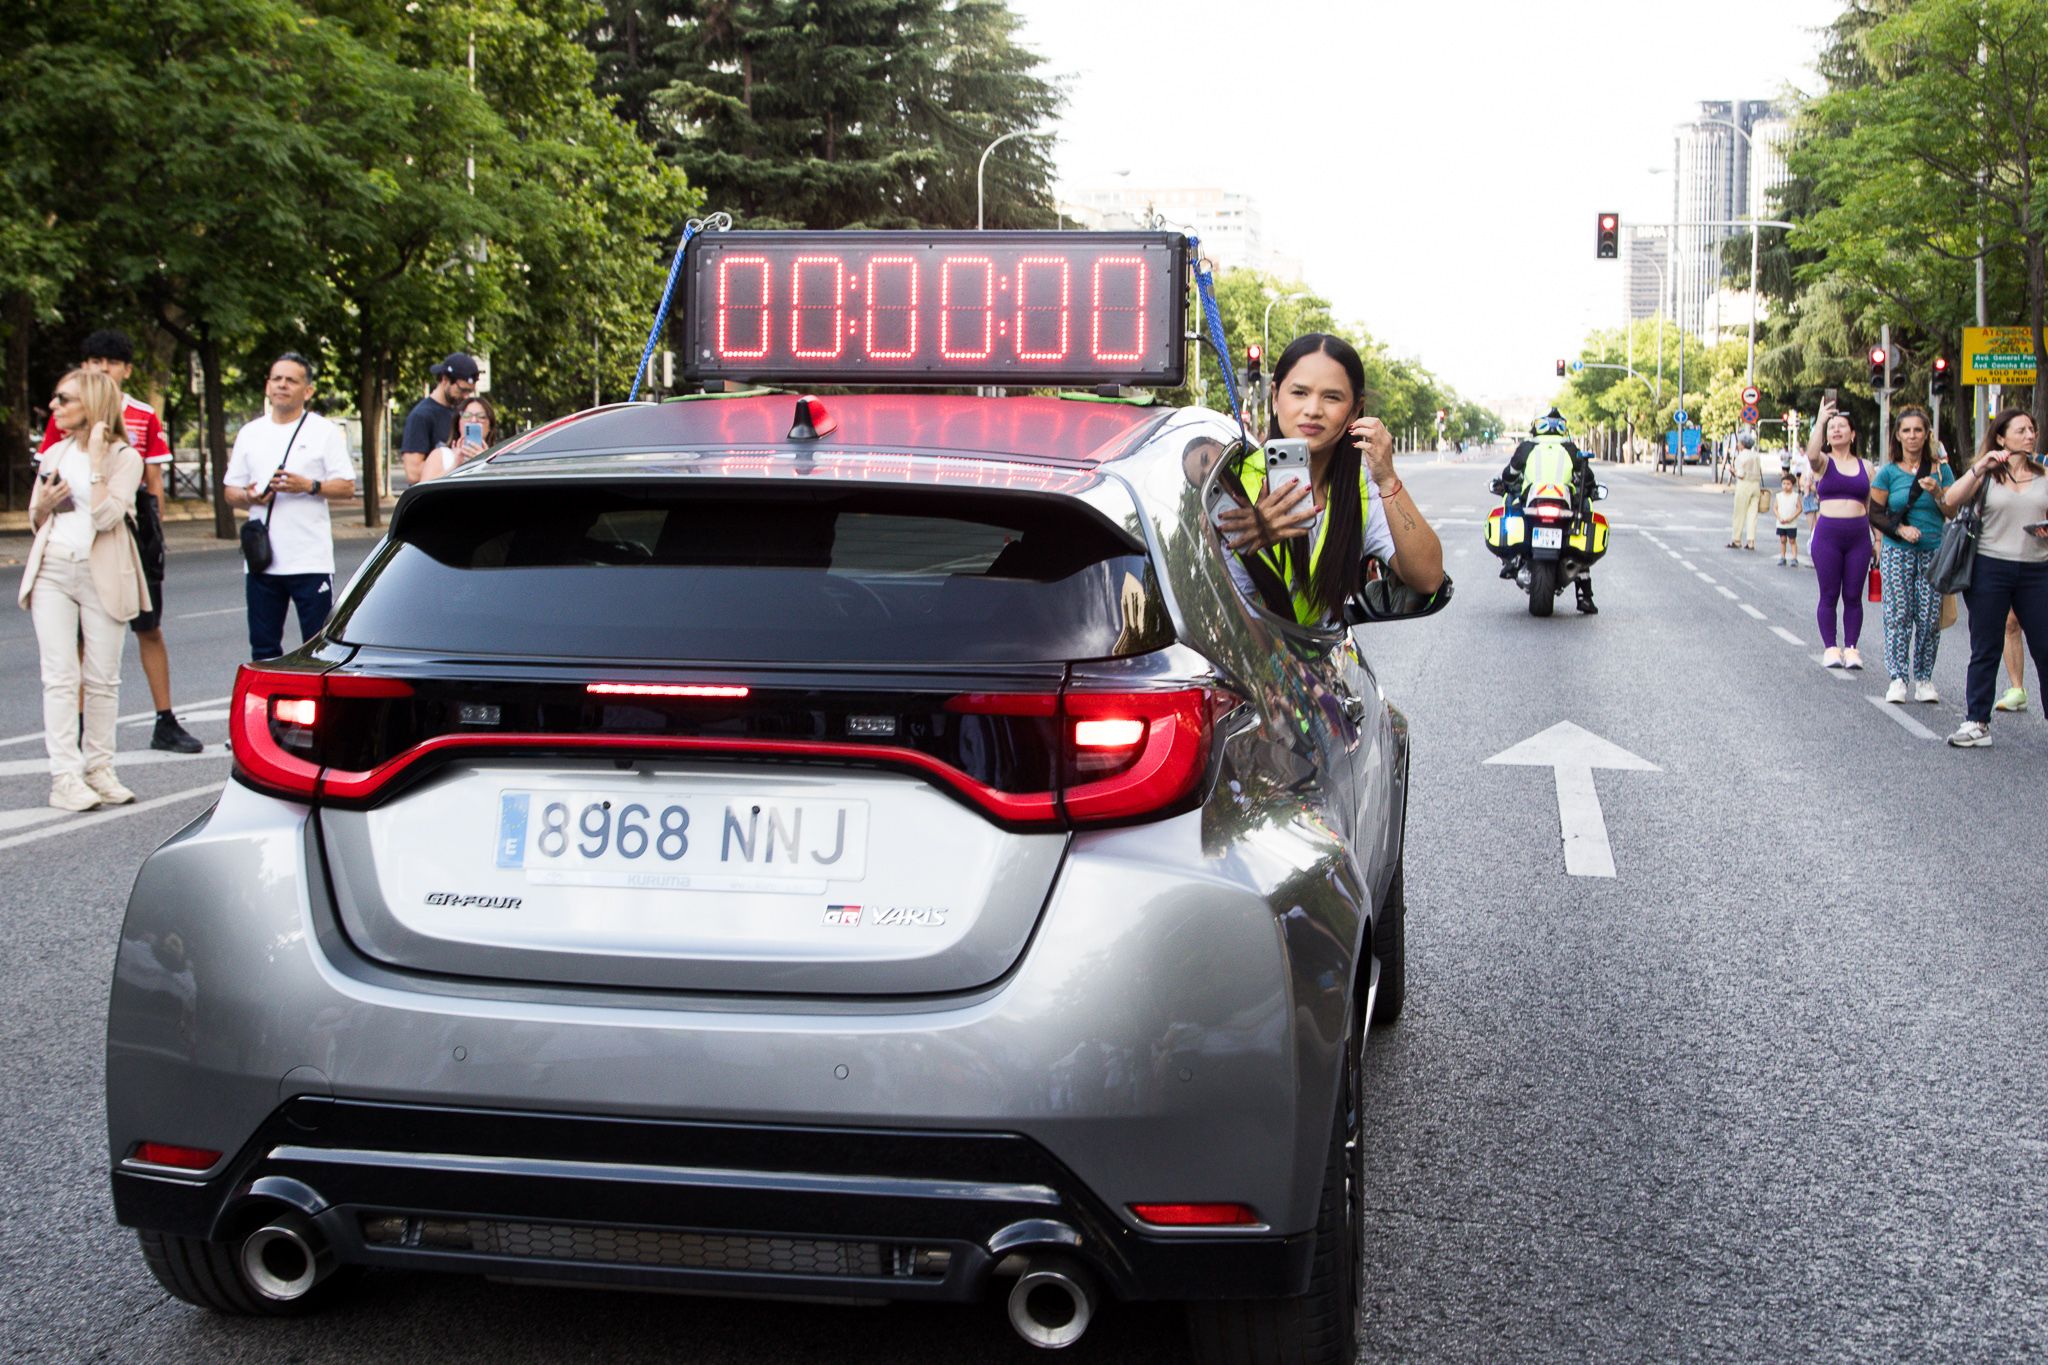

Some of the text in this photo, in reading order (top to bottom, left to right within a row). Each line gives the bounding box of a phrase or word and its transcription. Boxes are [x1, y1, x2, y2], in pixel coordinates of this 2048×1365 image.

[718, 257, 1146, 360] 00:00:00
[505, 838, 517, 856] E
[537, 801, 847, 865] 8968 NNJ
[822, 905, 949, 927] GR YARIS
